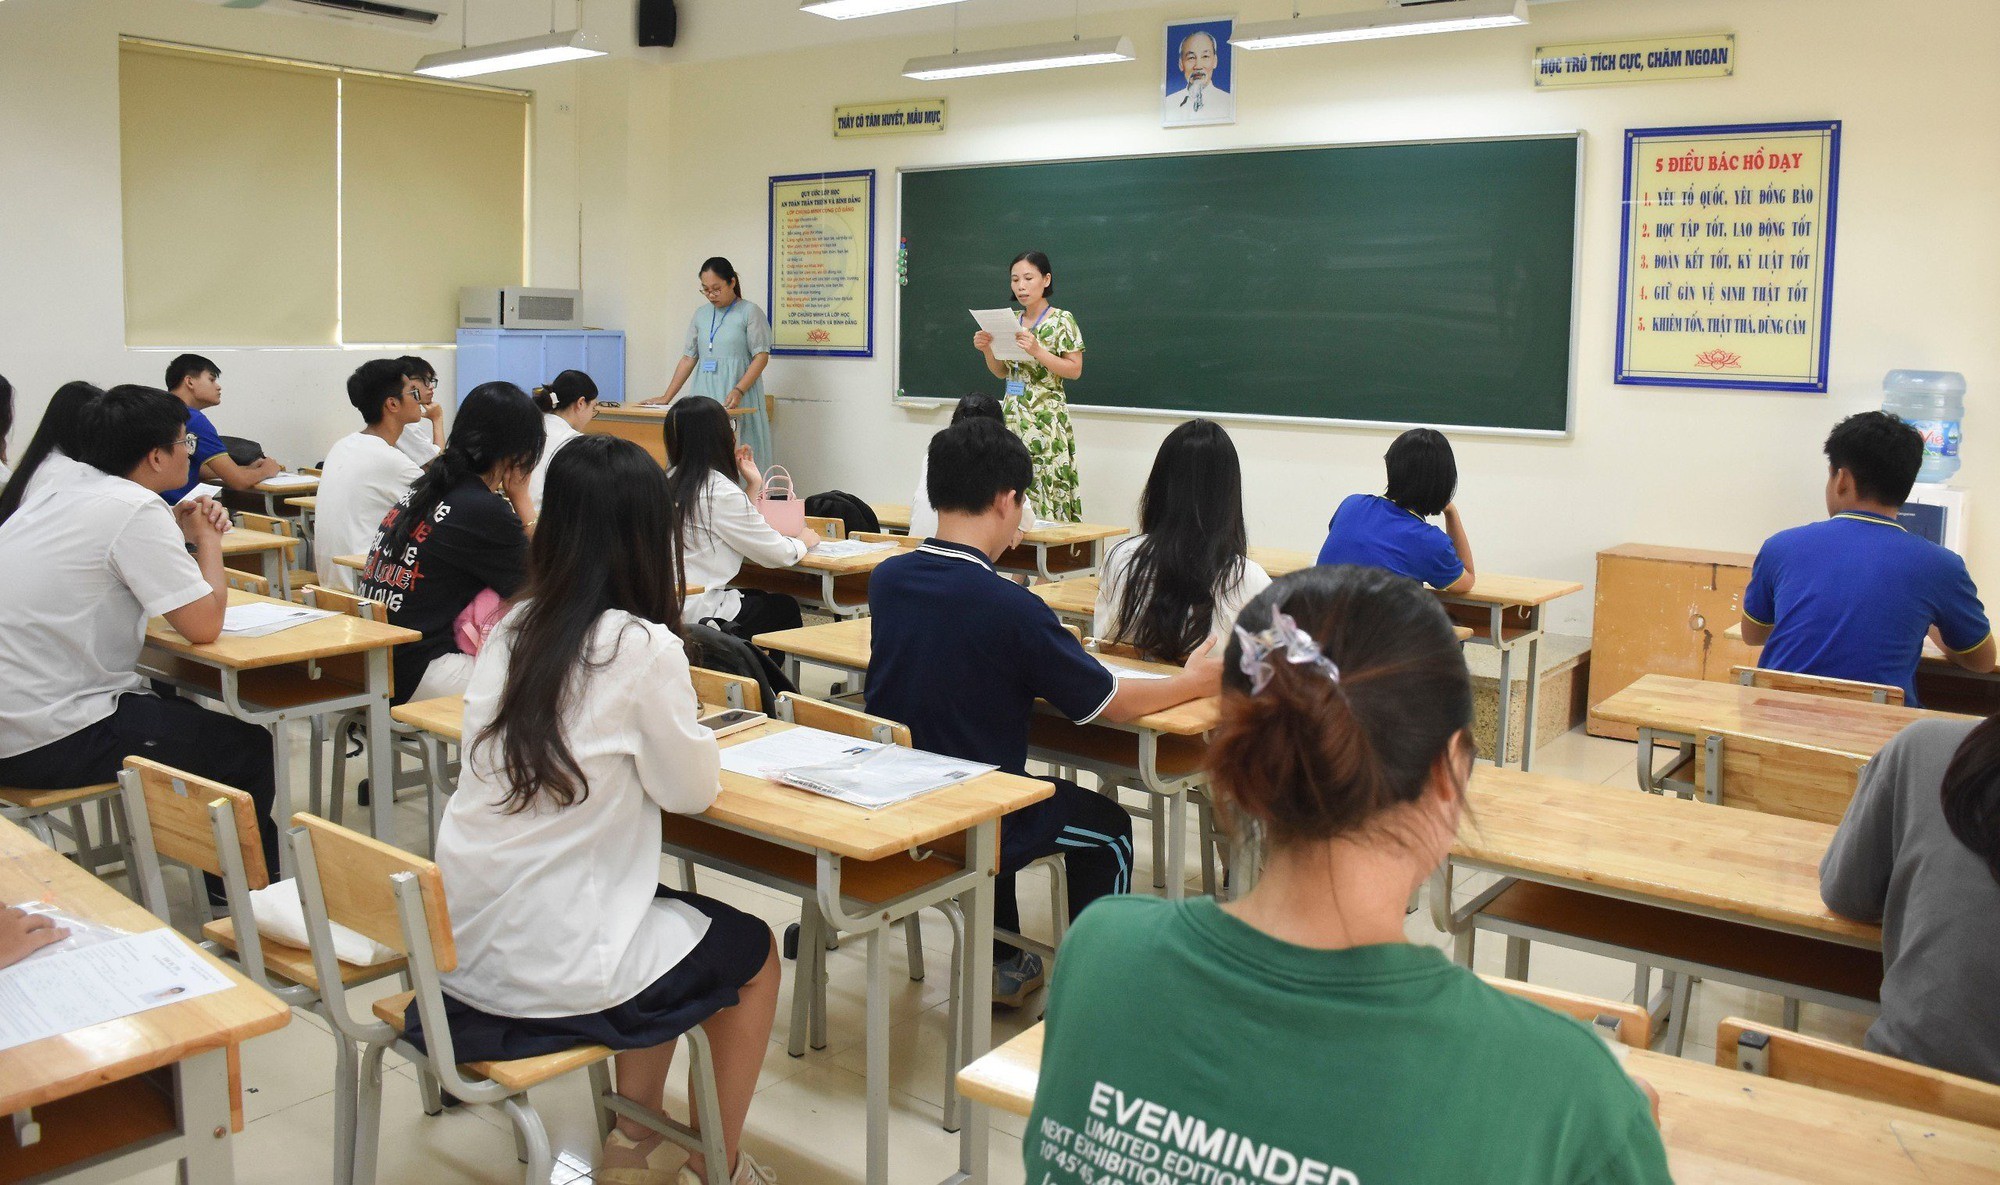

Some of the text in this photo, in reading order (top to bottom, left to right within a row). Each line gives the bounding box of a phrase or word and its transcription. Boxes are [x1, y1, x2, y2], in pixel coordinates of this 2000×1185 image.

[1540, 47, 1729, 77] HỌC TRÒ TÍCH CỰC, CHĂM NGOAN
[1655, 146, 1803, 173] 5 ĐIỀU BÁC HỒ DẠY
[1643, 192, 1651, 206] 1.
[1657, 187, 1675, 206] YÊU
[1734, 185, 1753, 205] YÊU
[1759, 181, 1786, 205] ĐỒNG
[1792, 184, 1813, 204] BÀO
[1642, 223, 1650, 237] 2.
[1655, 222, 1675, 242] HỌC
[1681, 218, 1700, 242] TẬP
[1733, 222, 1752, 237] LAO
[1758, 217, 1785, 242] ĐỘNG
[1792, 214, 1812, 237] TỐT
[1640, 254, 1649, 269] 3.
[1654, 250, 1679, 269] ĐOÀN
[1685, 246, 1704, 269] KẾT
[1737, 248, 1752, 269] KỶ
[1758, 250, 1784, 274] LUẬT
[1790, 247, 1810, 269] TỐT
[1654, 281, 1672, 300] GIỮ
[1677, 281, 1695, 300] GÌN
[1702, 281, 1714, 305] VỆ
[1721, 286, 1746, 301] SINH
[1752, 282, 1780, 306] THẬT
[1787, 279, 1808, 302] TỐT
[1652, 313, 1682, 332] KHIÊM
[1707, 314, 1733, 337] THẬT
[1758, 315, 1783, 334] DŨNG
[1785, 313, 1806, 334] CẢM
[1040, 1116, 1075, 1147] NEXT
[1085, 1116, 1161, 1164] LIMITED
